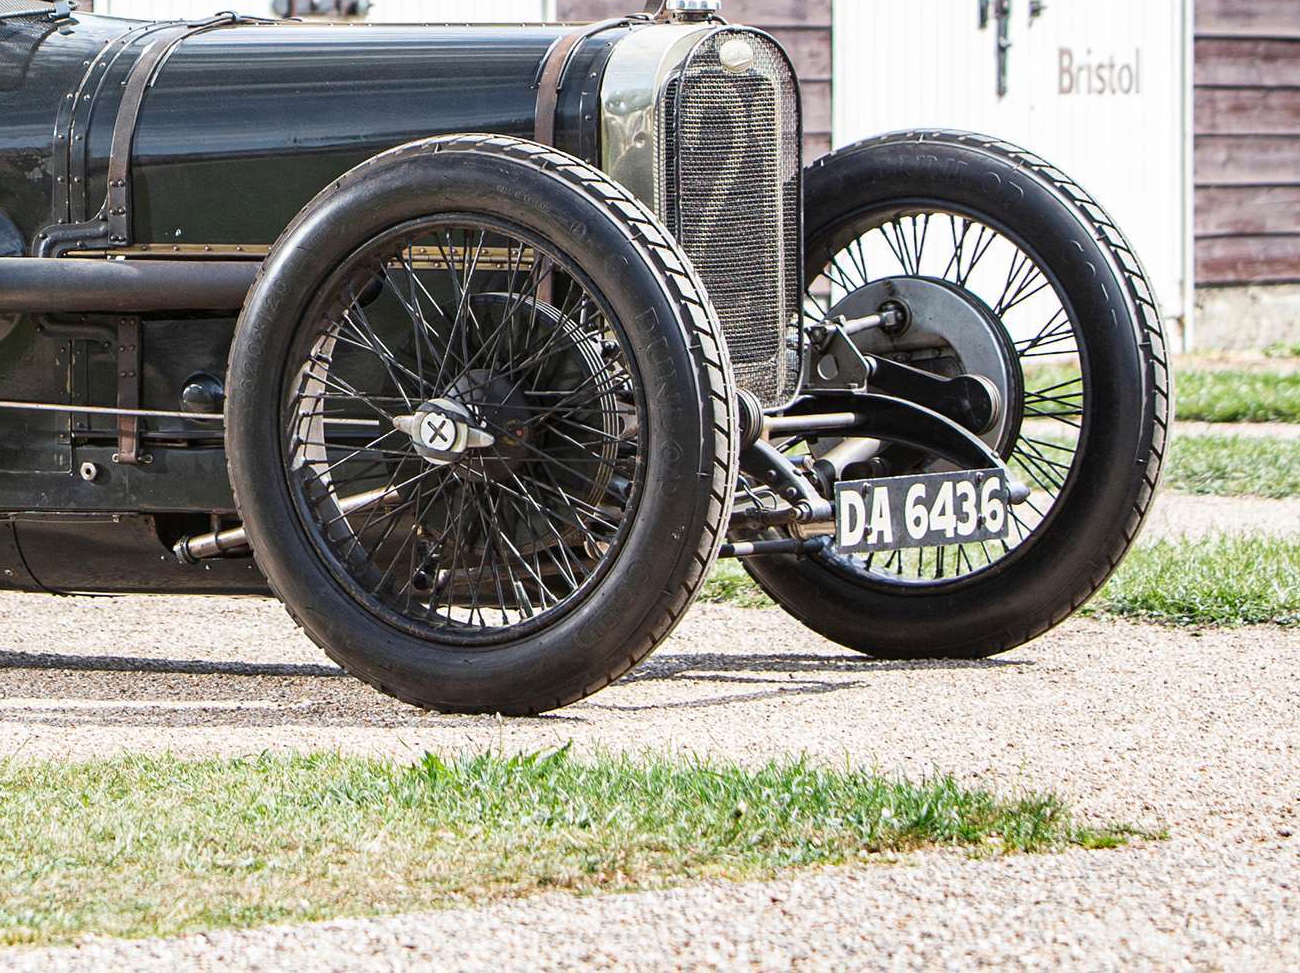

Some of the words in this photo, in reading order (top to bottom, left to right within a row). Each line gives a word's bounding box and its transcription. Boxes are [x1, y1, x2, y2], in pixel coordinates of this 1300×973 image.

[1057, 47, 1141, 95] Bristol
[839, 485, 895, 547] DA
[904, 476, 1006, 540] 6436
